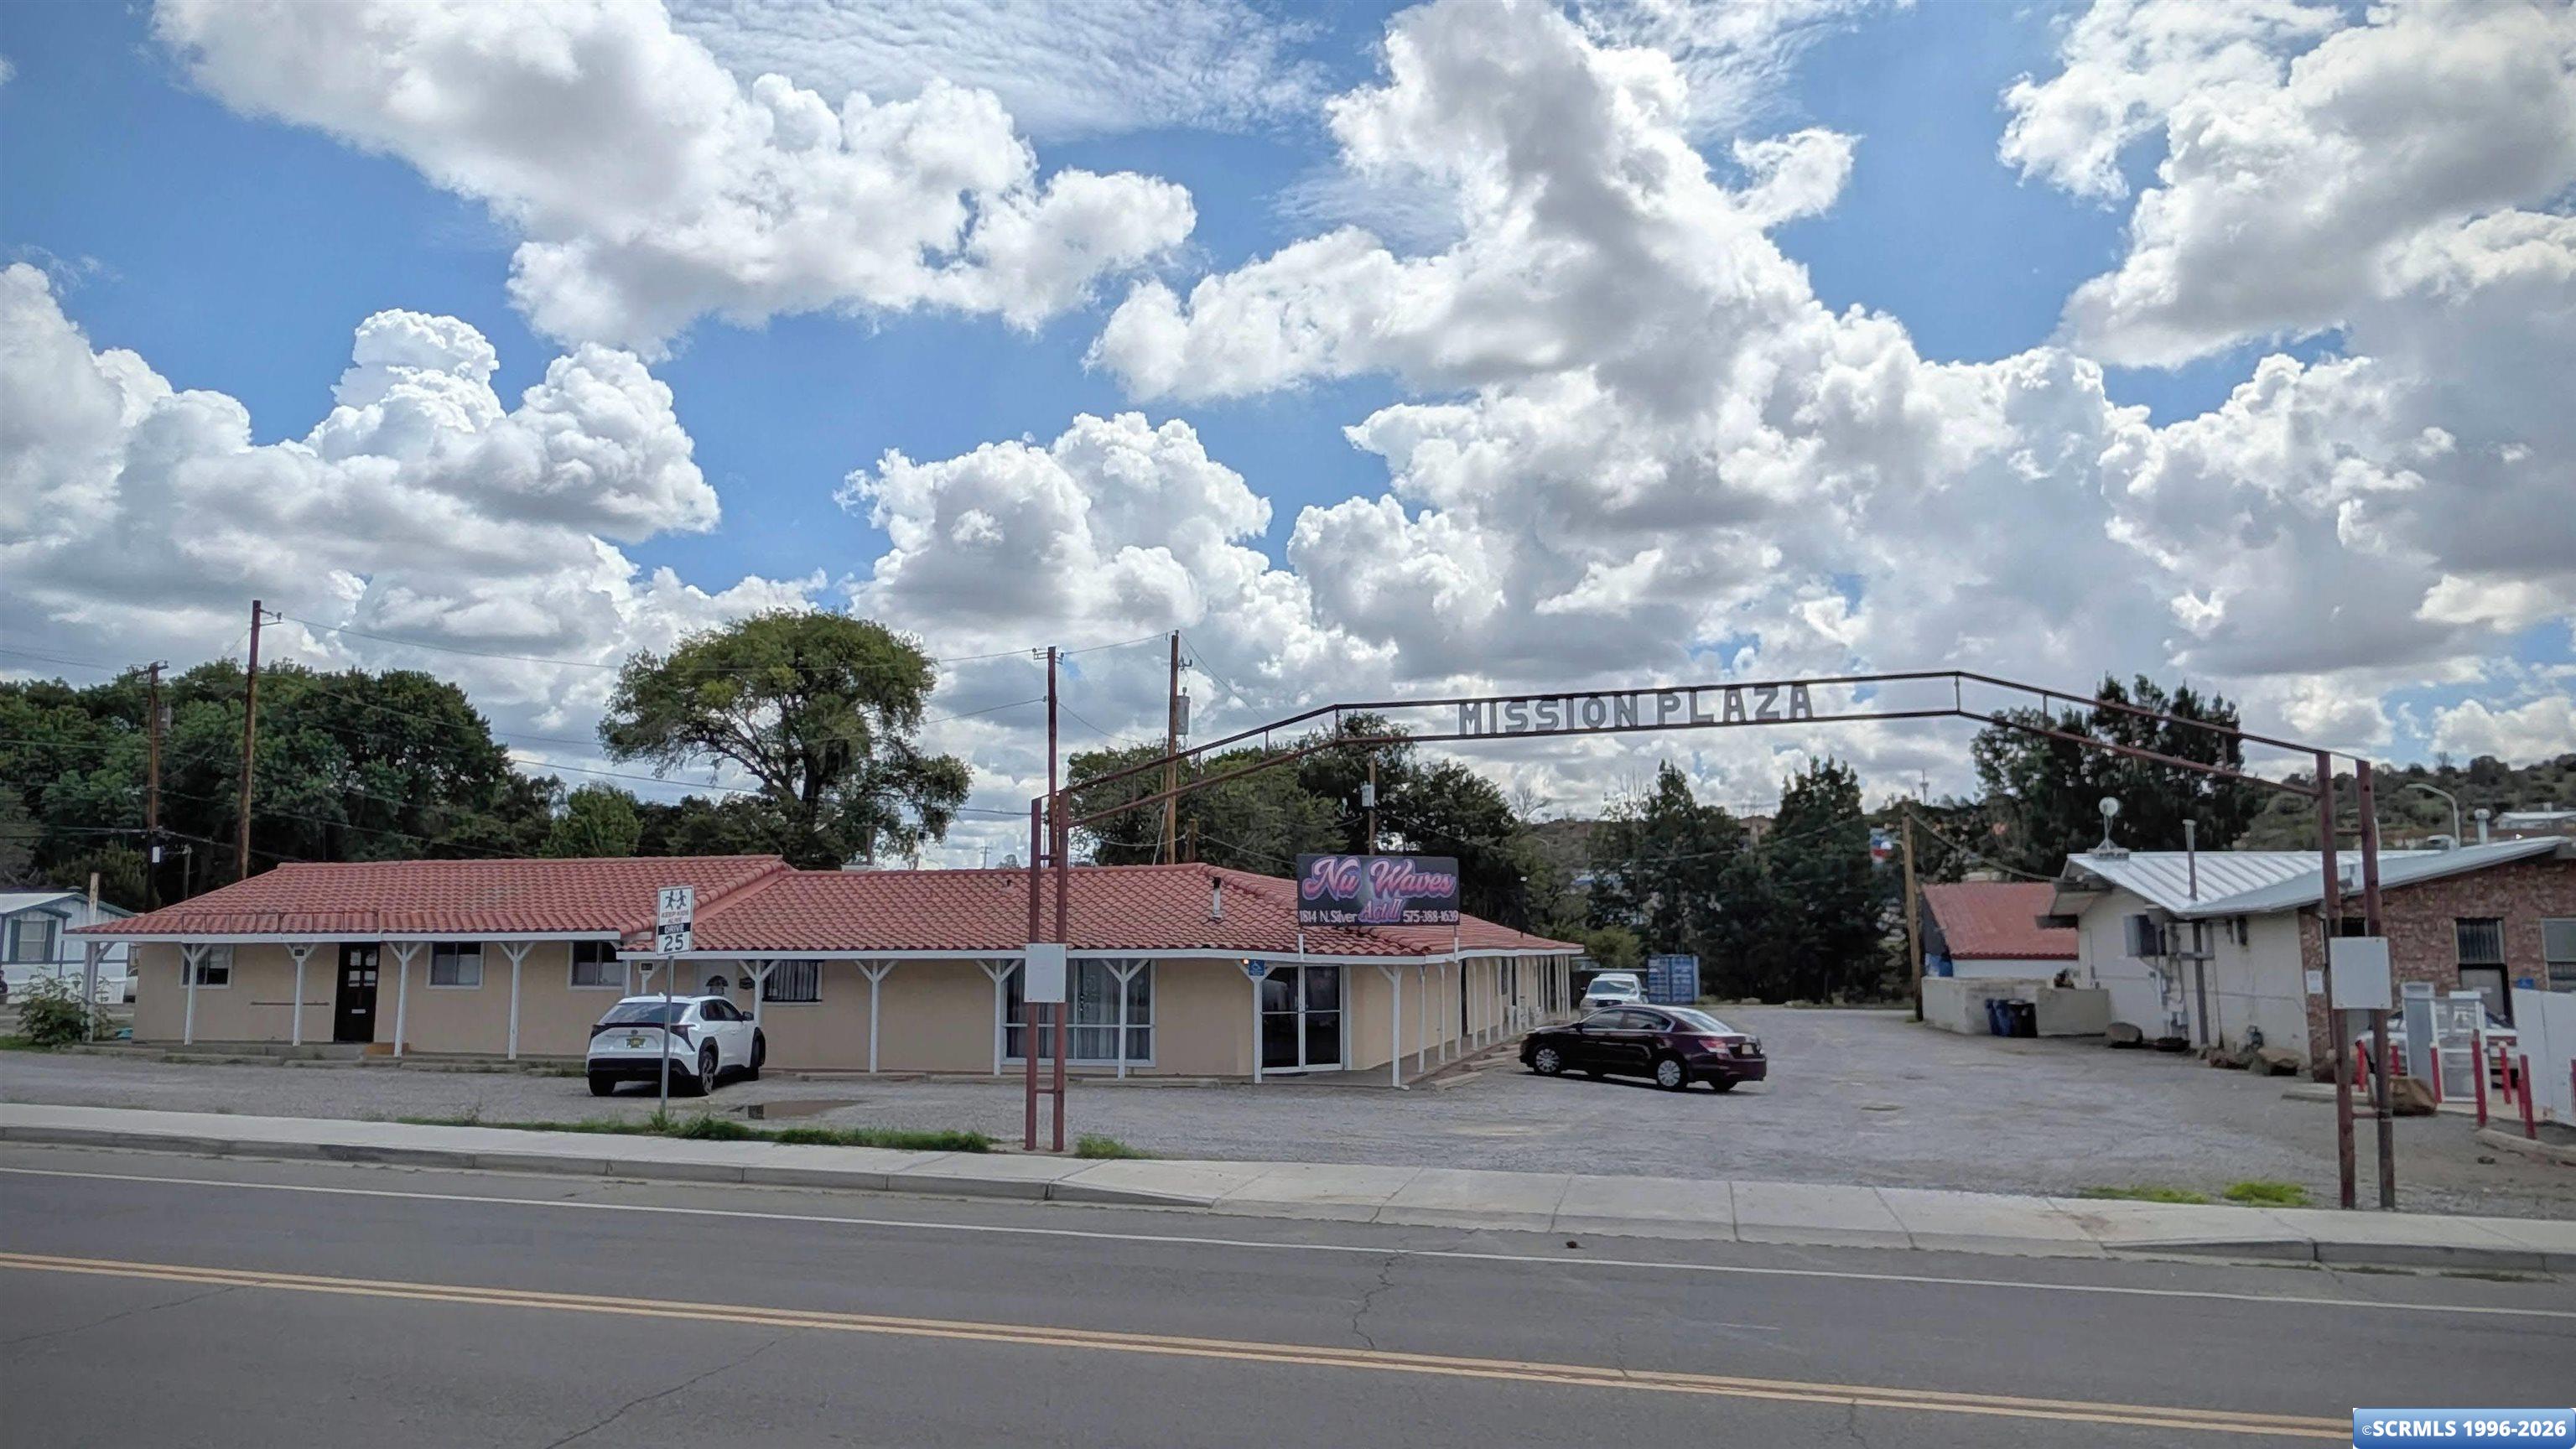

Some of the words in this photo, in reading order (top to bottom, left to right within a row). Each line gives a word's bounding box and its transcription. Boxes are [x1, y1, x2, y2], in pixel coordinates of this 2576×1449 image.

[1459, 694, 1638, 735] MISSION
[1657, 684, 1813, 726] PLAZA
[1302, 857, 1362, 900] Nu
[1369, 858, 1457, 898] Waves
[1300, 910, 1317, 922] 1814
[1403, 910, 1458, 922] 575-388-1639
[664, 923, 684, 934] DRIVE
[664, 934, 683, 952] 25
